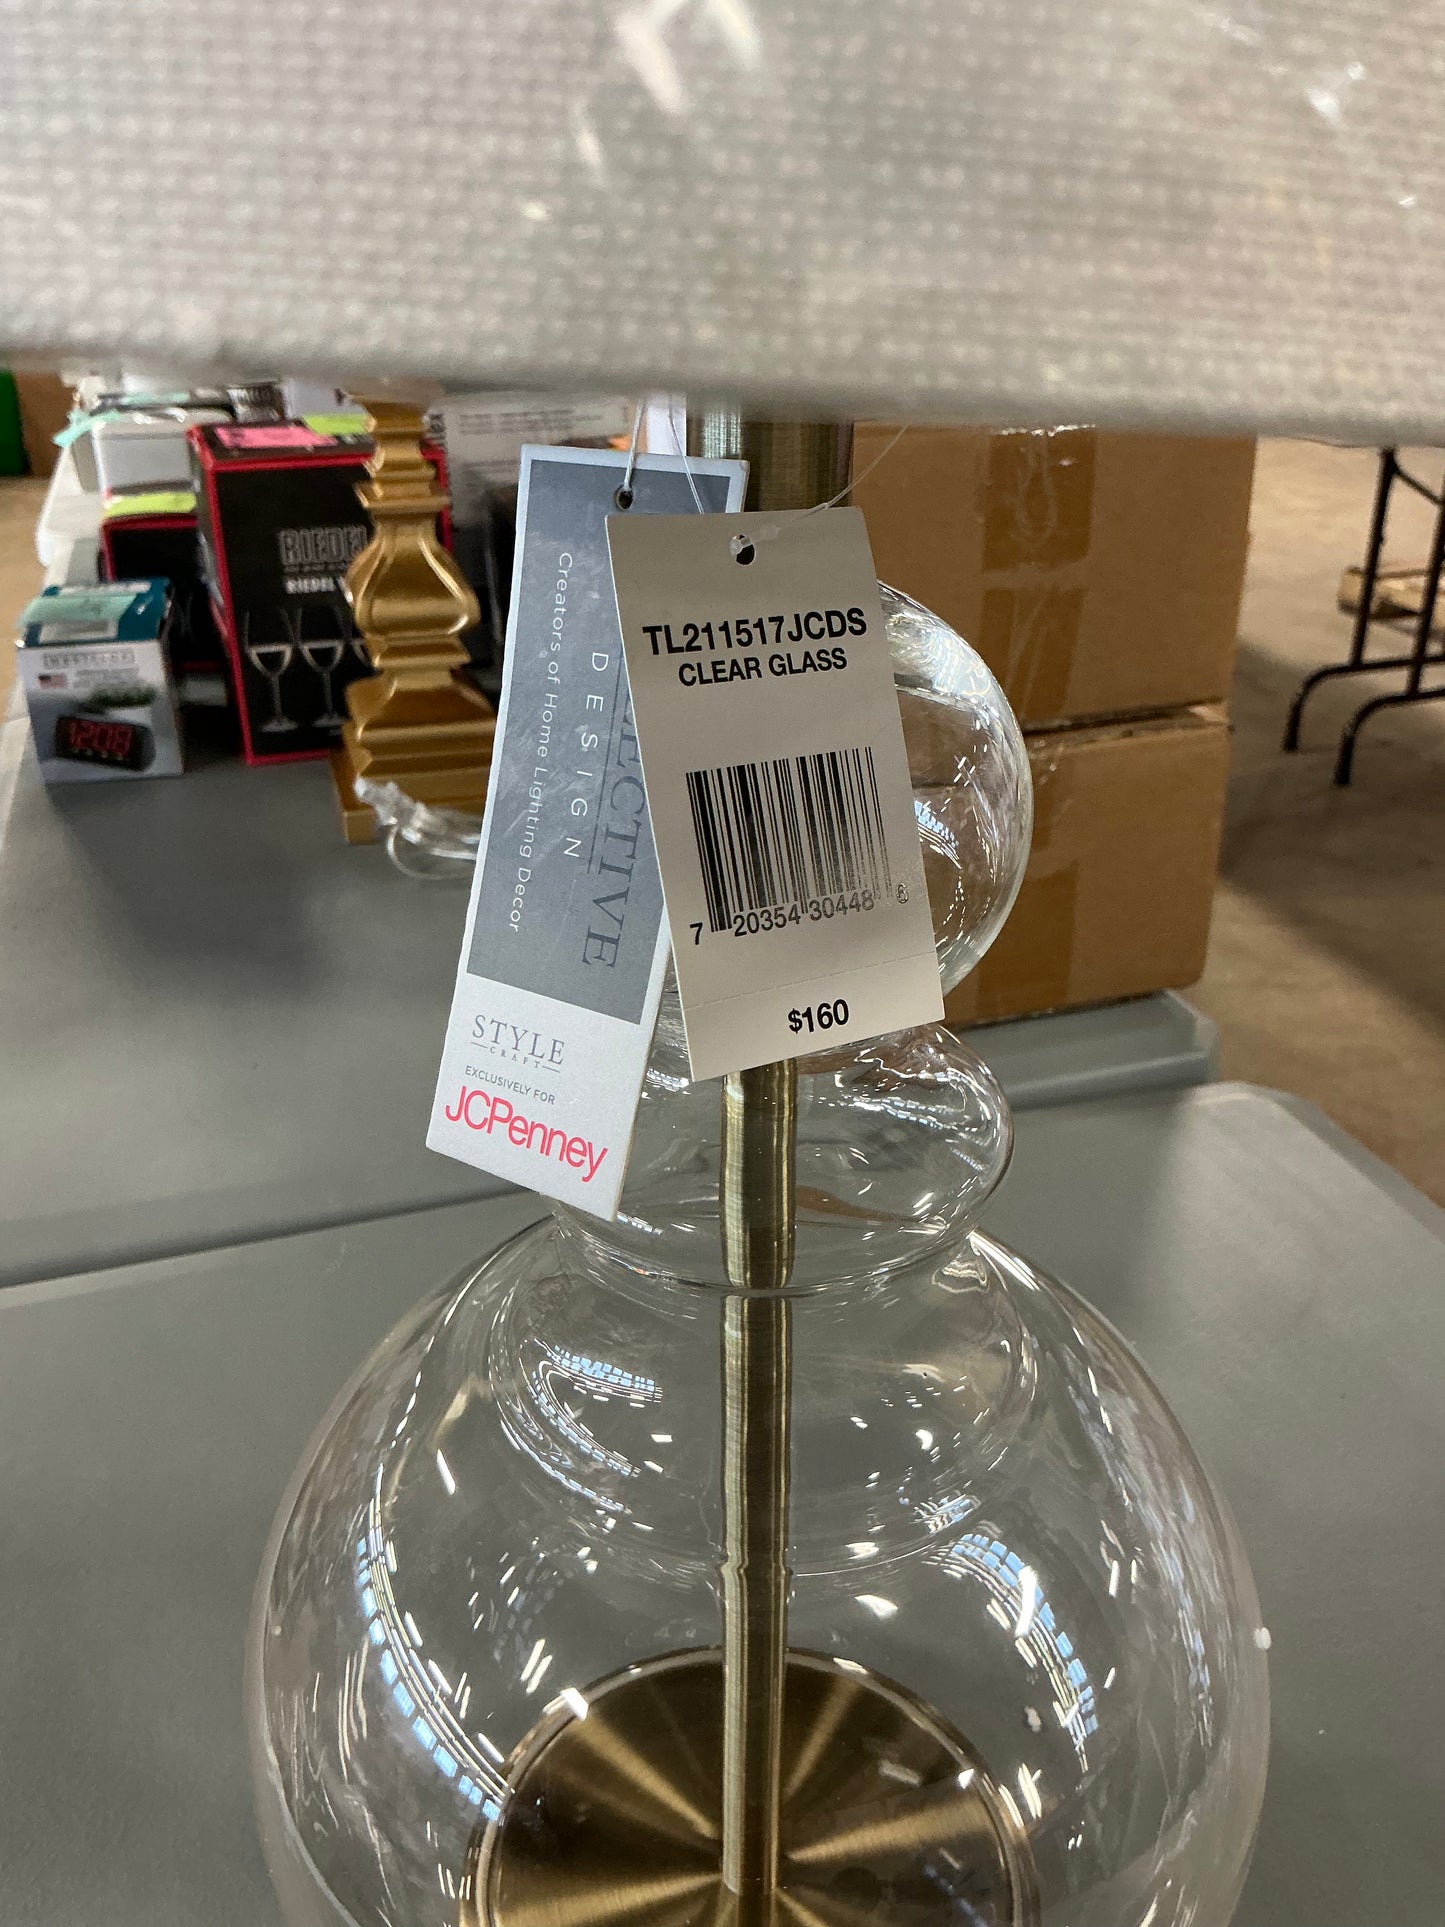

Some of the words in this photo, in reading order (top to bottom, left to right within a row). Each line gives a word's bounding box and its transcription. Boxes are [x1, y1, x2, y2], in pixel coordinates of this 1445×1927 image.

[551, 552, 573, 652] Creators
[642, 607, 867, 656] TL211517JCDS
[547, 661, 561, 685] of
[678, 656, 763, 687] CLEAR
[768, 647, 848, 677] GLASS
[537, 693, 559, 758] Home
[563, 652, 609, 858] DESIGN
[519, 767, 548, 858] Lighting
[509, 867, 532, 932] Decor
[689, 922, 703, 946] 7
[732, 903, 802, 937] 20354
[808, 889, 875, 922] 30448
[472, 1014, 565, 1065] STYLE
[788, 998, 849, 1034] $160
[489, 1046, 540, 1069] CRAFT
[465, 1065, 531, 1096] EXCLUSIVELY
[533, 1089, 556, 1105] FOR
[445, 1085, 608, 1183] JCPenney
